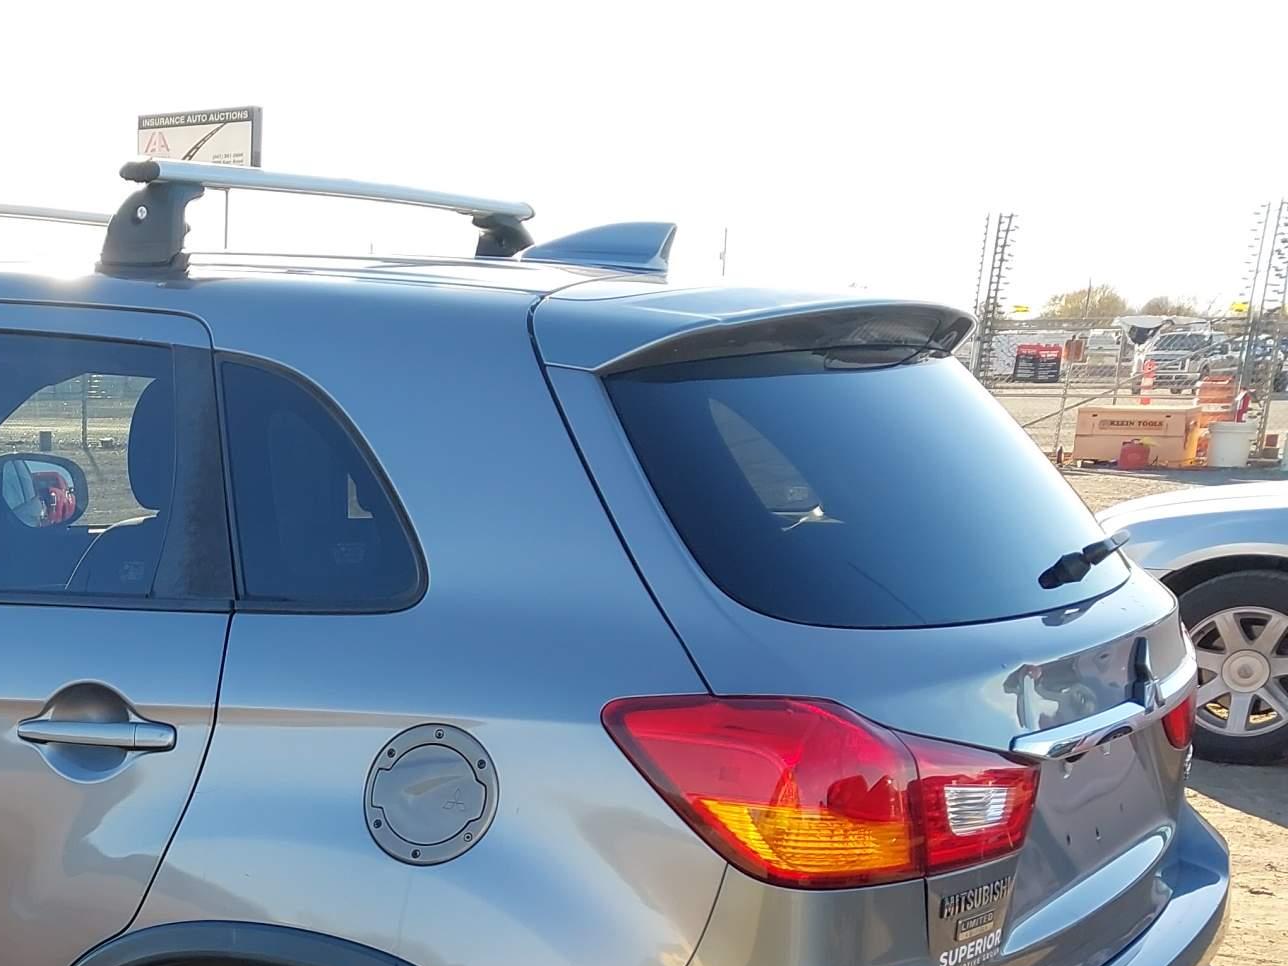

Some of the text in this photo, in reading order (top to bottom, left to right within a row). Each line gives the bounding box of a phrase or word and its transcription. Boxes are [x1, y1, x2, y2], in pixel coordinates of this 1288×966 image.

[142, 110, 249, 127] INSURANCE AUTO AUCTIONS
[941, 876, 1013, 918] MITSUBISHI
[961, 912, 993, 931] LIMITED
